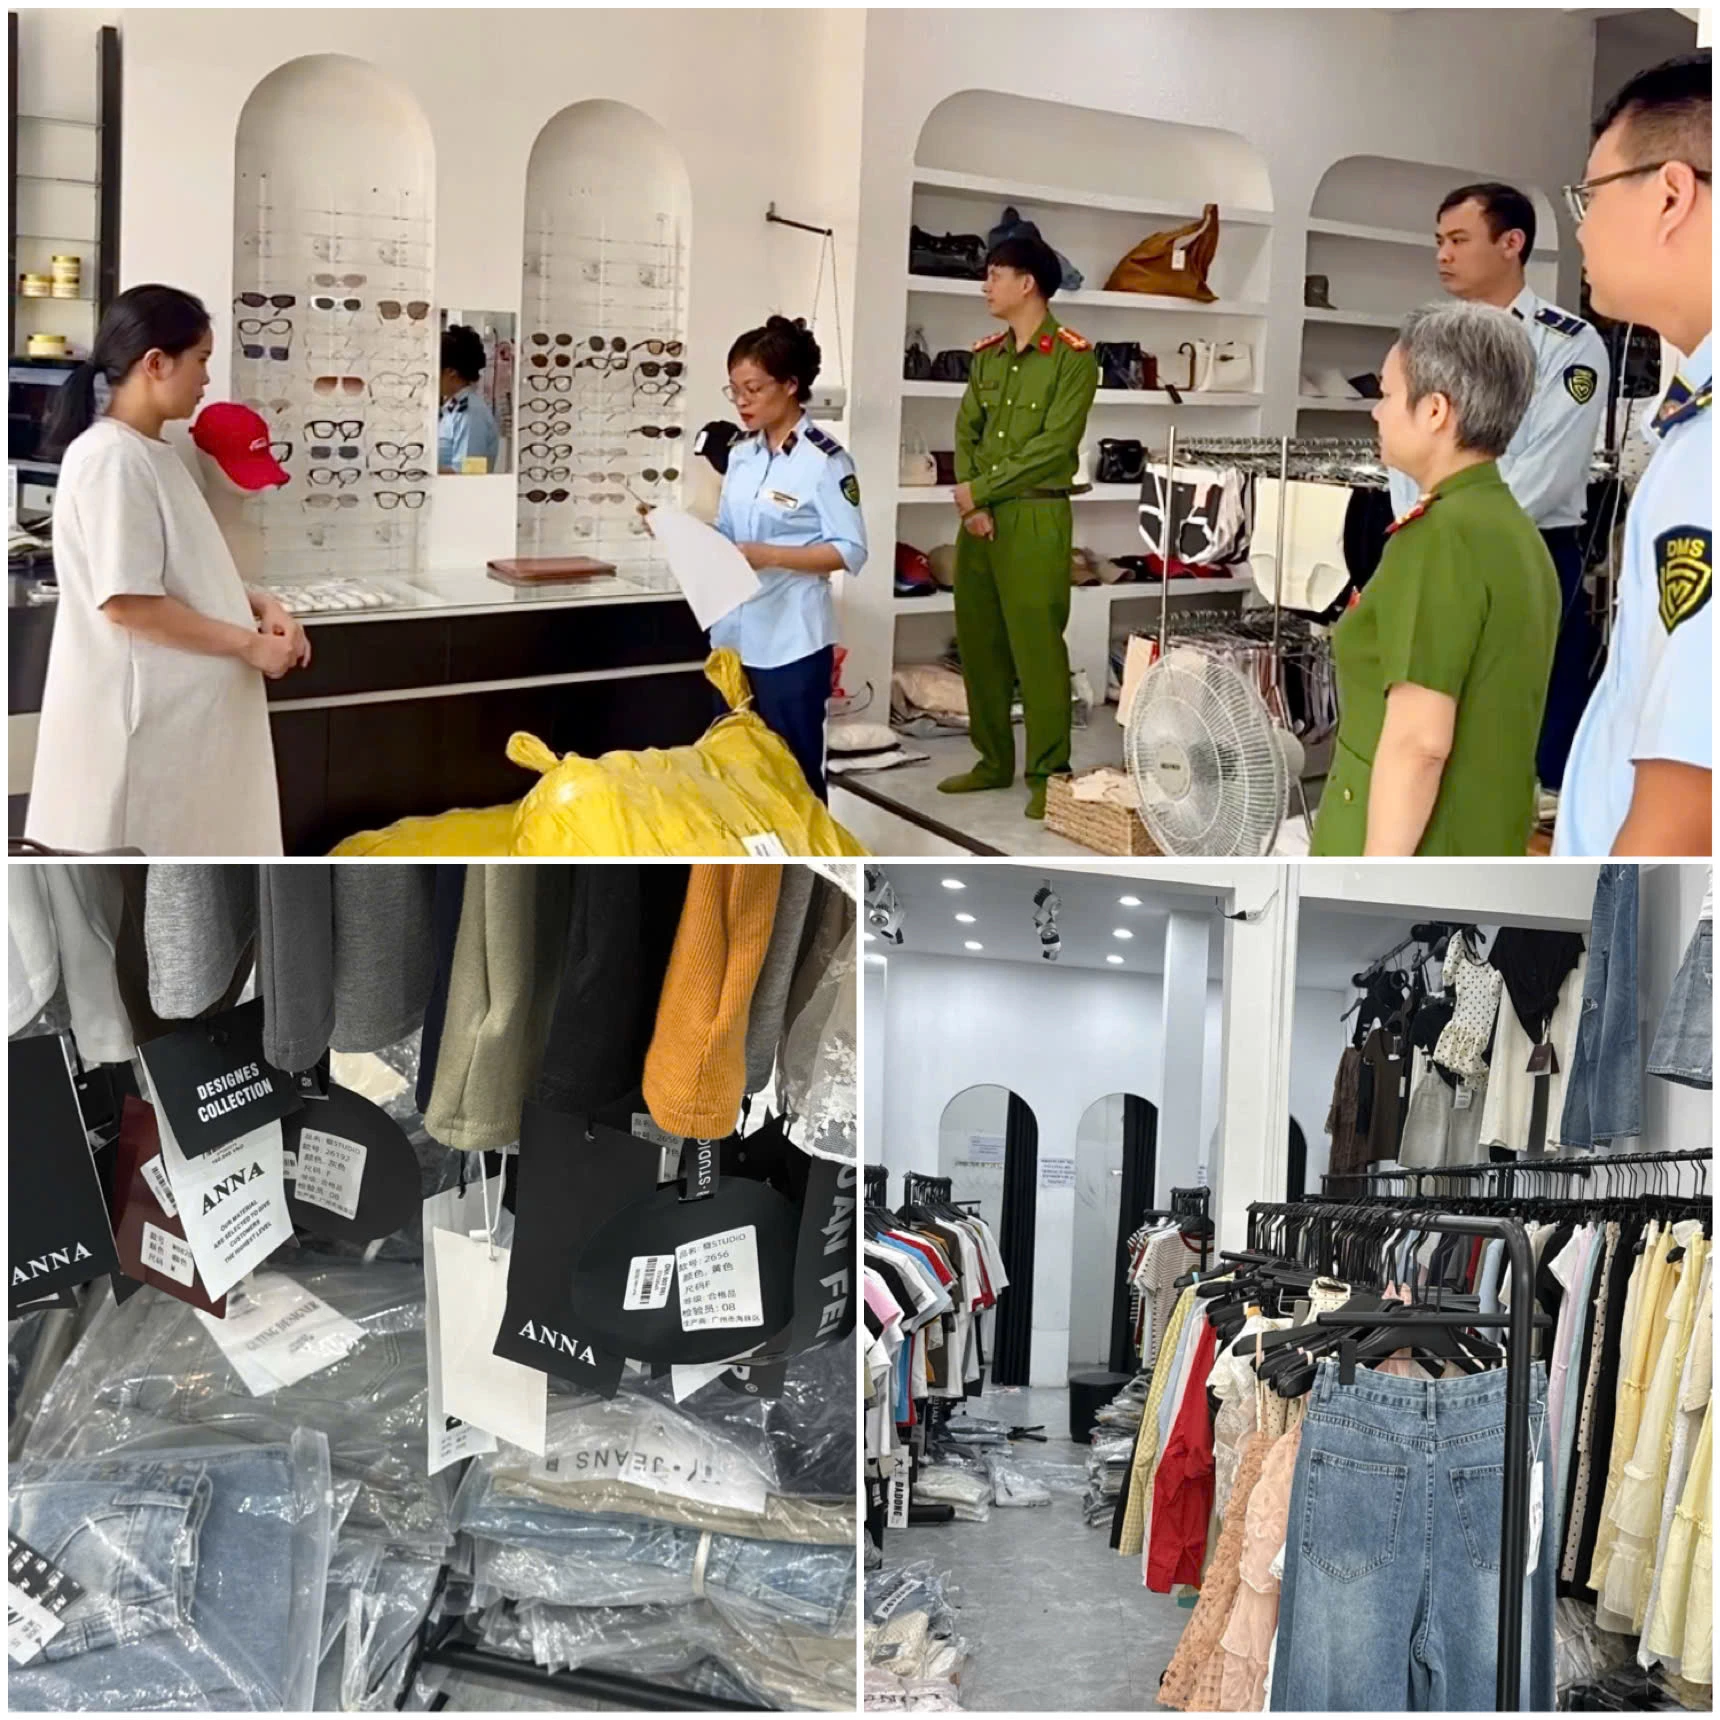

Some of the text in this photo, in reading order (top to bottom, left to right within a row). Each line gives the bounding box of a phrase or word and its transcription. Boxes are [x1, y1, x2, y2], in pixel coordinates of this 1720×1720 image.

[1666, 537, 1705, 558] DMS
[197, 1062, 260, 1100] DESIGNES
[197, 1077, 274, 1123] COLLECTION
[202, 1161, 265, 1216] ANNA
[11, 1241, 93, 1286] ANNA
[704, 1250, 730, 1263] 2656
[720, 1302, 736, 1312] 08
[518, 1319, 597, 1367] ANNA
[576, 1449, 664, 1473] JEANS
